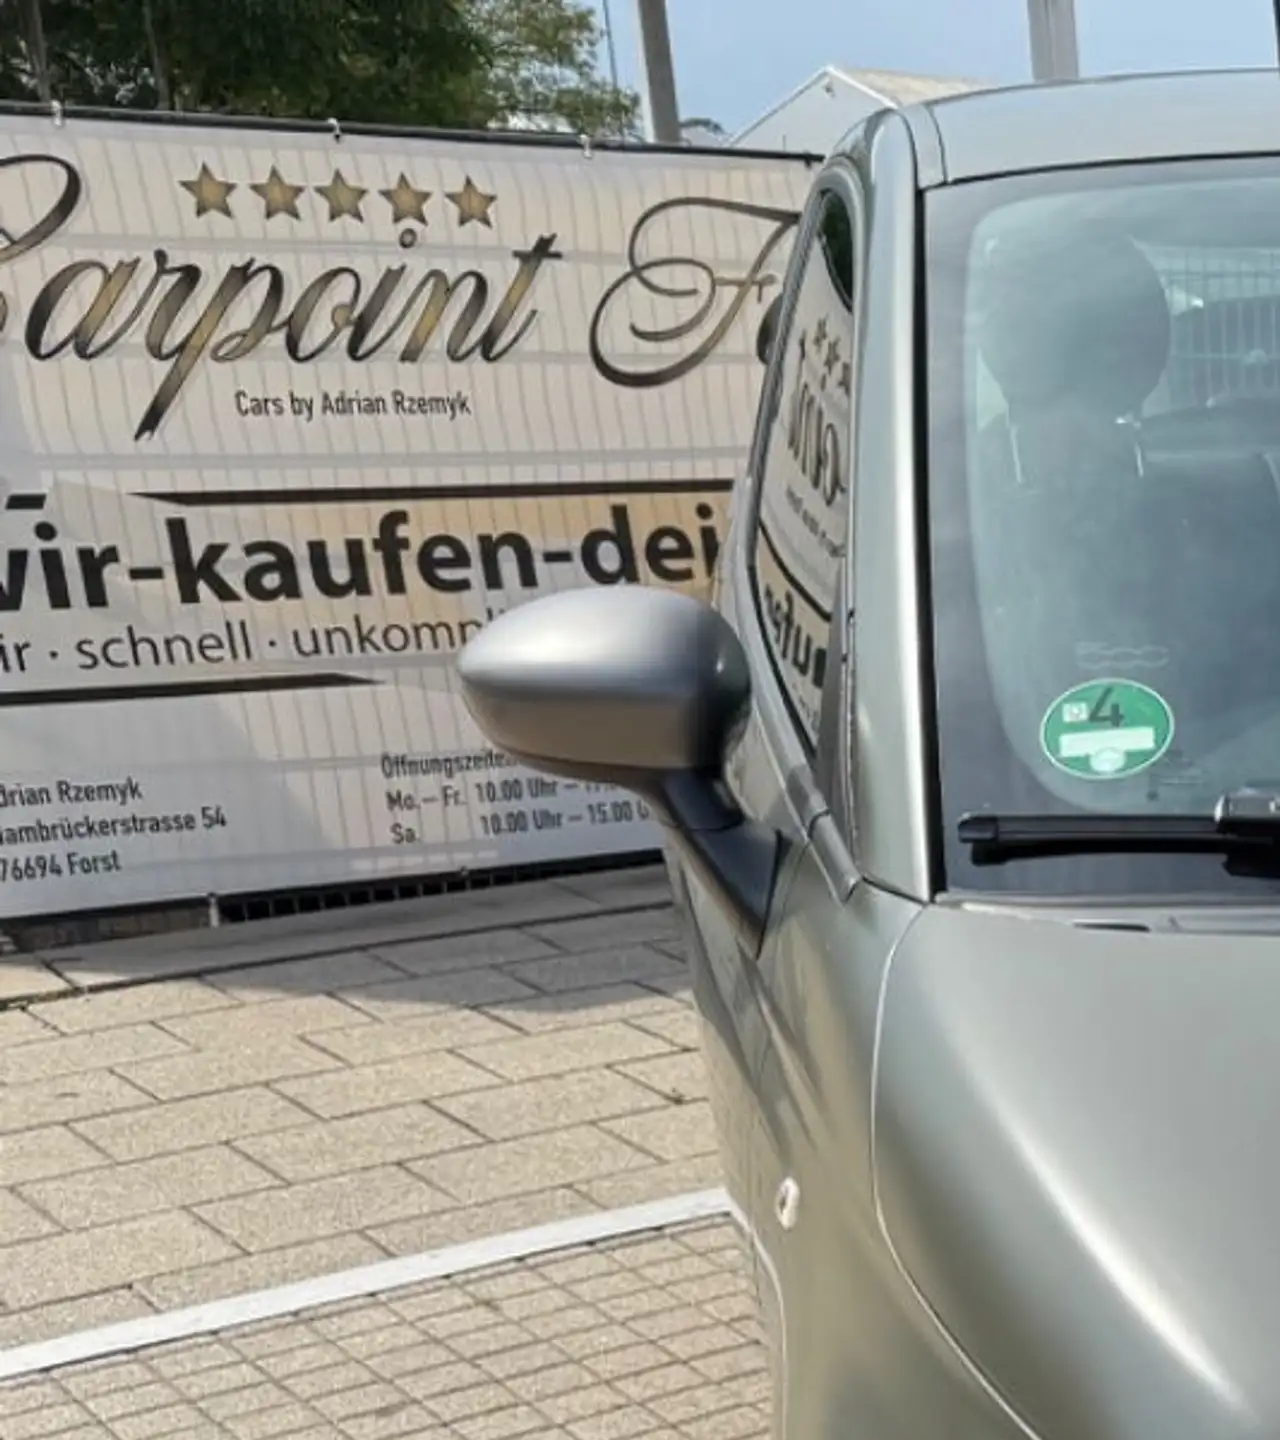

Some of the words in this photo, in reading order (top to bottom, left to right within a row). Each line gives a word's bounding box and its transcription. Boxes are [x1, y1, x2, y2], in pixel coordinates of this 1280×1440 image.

[234, 390, 285, 417] Cars
[290, 390, 314, 422] by
[321, 390, 387, 416] Adrian
[391, 389, 471, 420] Rzemyk
[76, 620, 253, 671] schnell
[1088, 685, 1125, 729] 4
[56, 776, 143, 805] Rzemyk
[201, 804, 227, 830] 54
[67, 850, 121, 876] Forst
